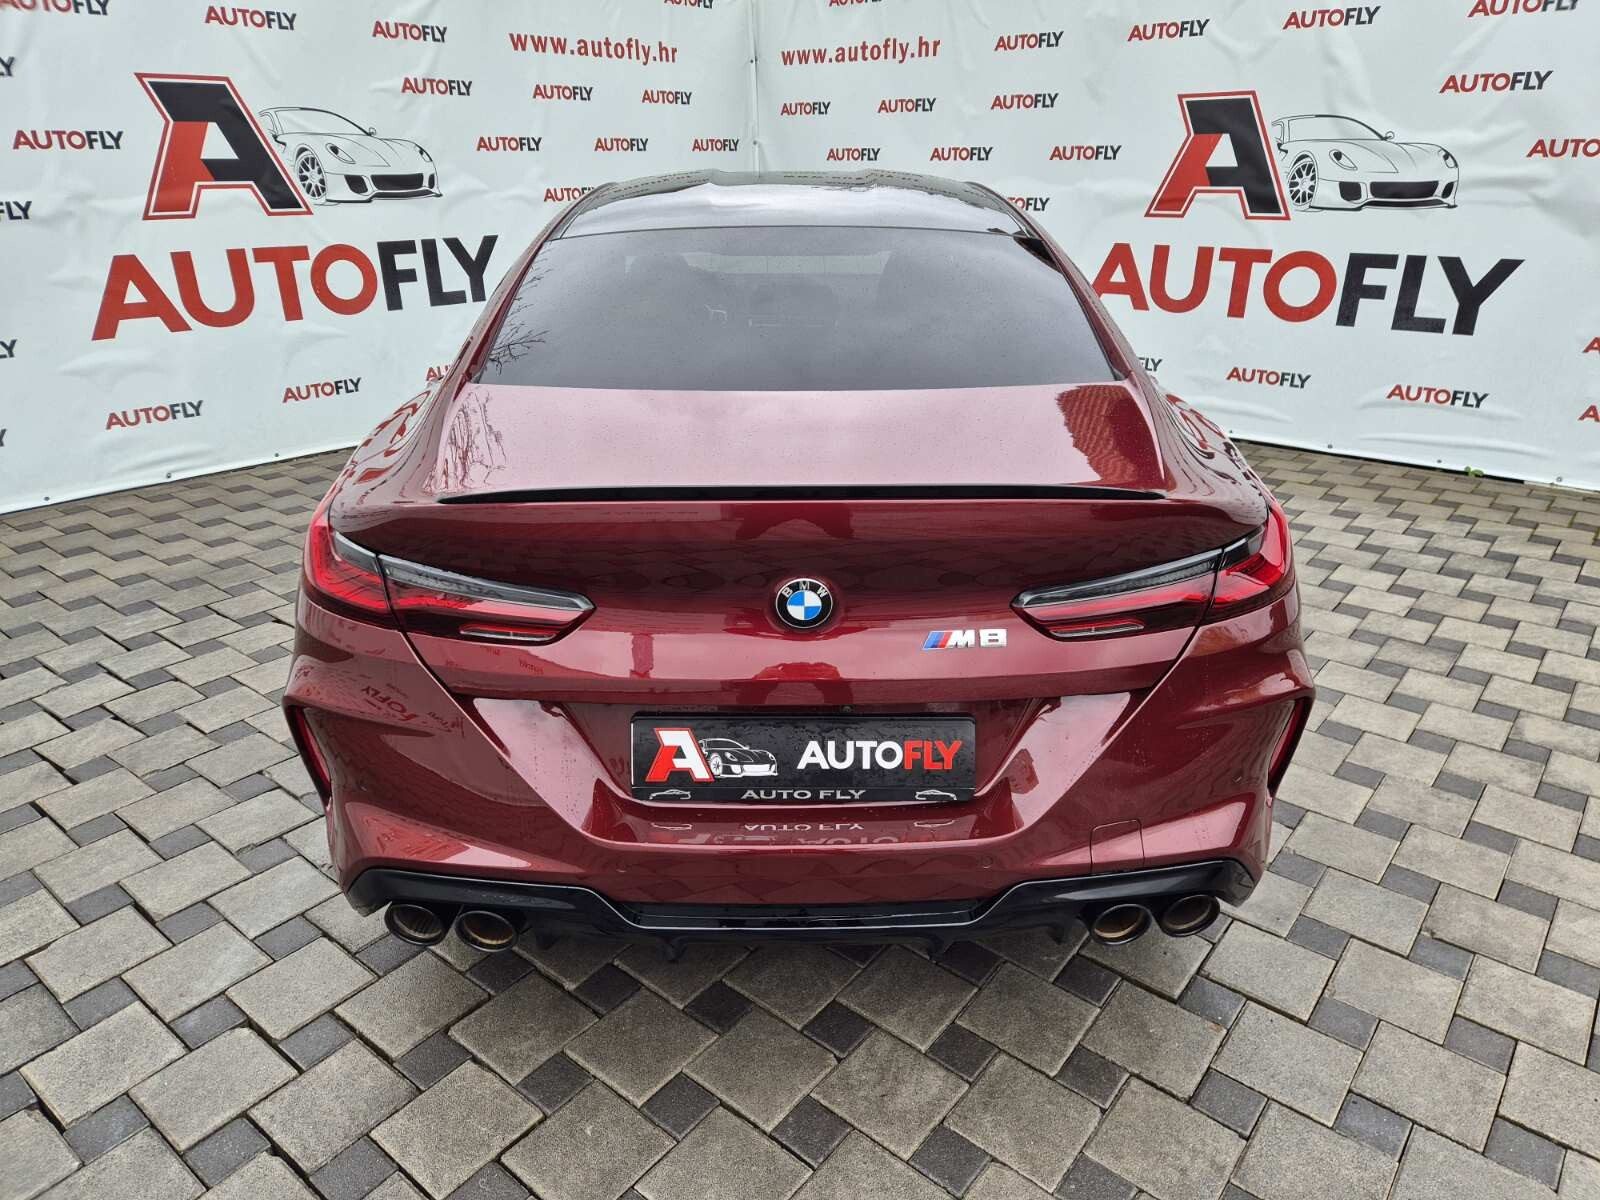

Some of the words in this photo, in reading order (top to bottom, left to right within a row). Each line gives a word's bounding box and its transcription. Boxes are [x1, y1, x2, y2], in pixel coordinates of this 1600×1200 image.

[205, 6, 296, 30] AUTOFLY
[1283, 5, 1380, 29] AUTOFLY
[372, 20, 447, 42] AUTOFLY
[1128, 18, 1209, 41] AUTOFLY
[509, 33, 677, 65] www.autofly.hr
[781, 36, 941, 65] www.autofly.hr
[994, 31, 1063, 51] AUTOFLY
[402, 77, 472, 96] AUTOFLY
[1439, 70, 1553, 93] AUTOFLY
[533, 84, 593, 101] AUTOFLY
[642, 89, 692, 105] AUTOFLY
[991, 93, 1059, 110] AUTOFLY
[781, 101, 831, 116] AUTOFLY
[878, 98, 936, 114] AUTOFLY
[13, 130, 124, 150] AUTOFLY
[477, 136, 543, 151] AUTOFLY
[594, 137, 648, 151] AUTOFLY
[692, 138, 739, 152] AUTOFLY
[1526, 138, 1600, 157] AUTO
[827, 148, 880, 161] AUTOFLY
[930, 147, 993, 161] AUTOFLY
[1050, 145, 1122, 160] AUTOFLY
[0, 201, 32, 220] LY
[92, 234, 499, 341] AUTOFLY
[1093, 242, 1526, 336] AUTOFLY
[1226, 366, 1312, 389] AUTOFLY
[283, 377, 361, 403] AUTOFLY
[1386, 384, 1489, 409] AUTOFLY
[106, 400, 204, 430] AUTOFLY
[781, 581, 828, 598] BMW
[945, 628, 1009, 649] M8
[796, 739, 963, 771] AUTOFLY
[741, 790, 814, 800] AUTO
[819, 790, 866, 800] FLY
